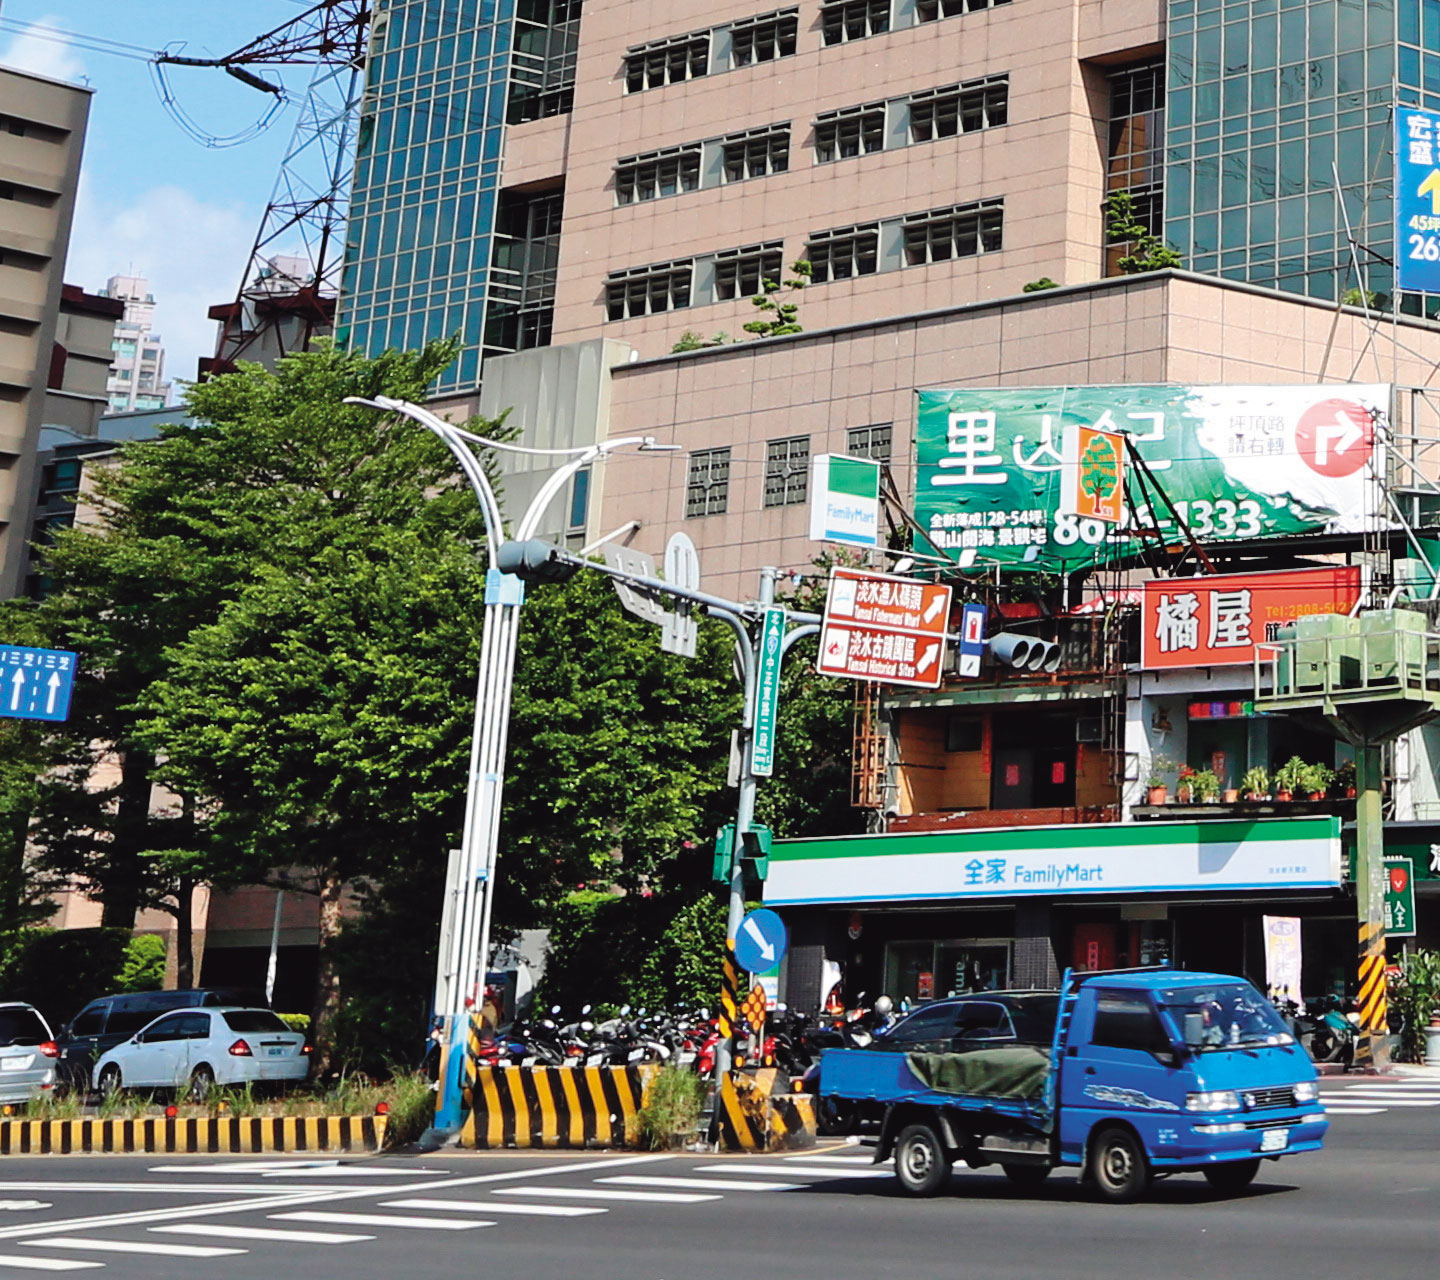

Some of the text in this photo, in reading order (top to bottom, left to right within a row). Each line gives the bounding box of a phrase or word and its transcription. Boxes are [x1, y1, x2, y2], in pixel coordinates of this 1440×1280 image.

[1407, 115, 1433, 166] 宏盛
[1228, 414, 1285, 433] 坪頂路
[1228, 435, 1285, 456] 請右轉
[826, 504, 876, 524] FamilyMart
[1156, 588, 1255, 653] 橘屋
[9, 651, 35, 667] 三芝
[44, 655, 71, 671] 三芝
[964, 858, 1104, 887] 全家 FamilyMart
